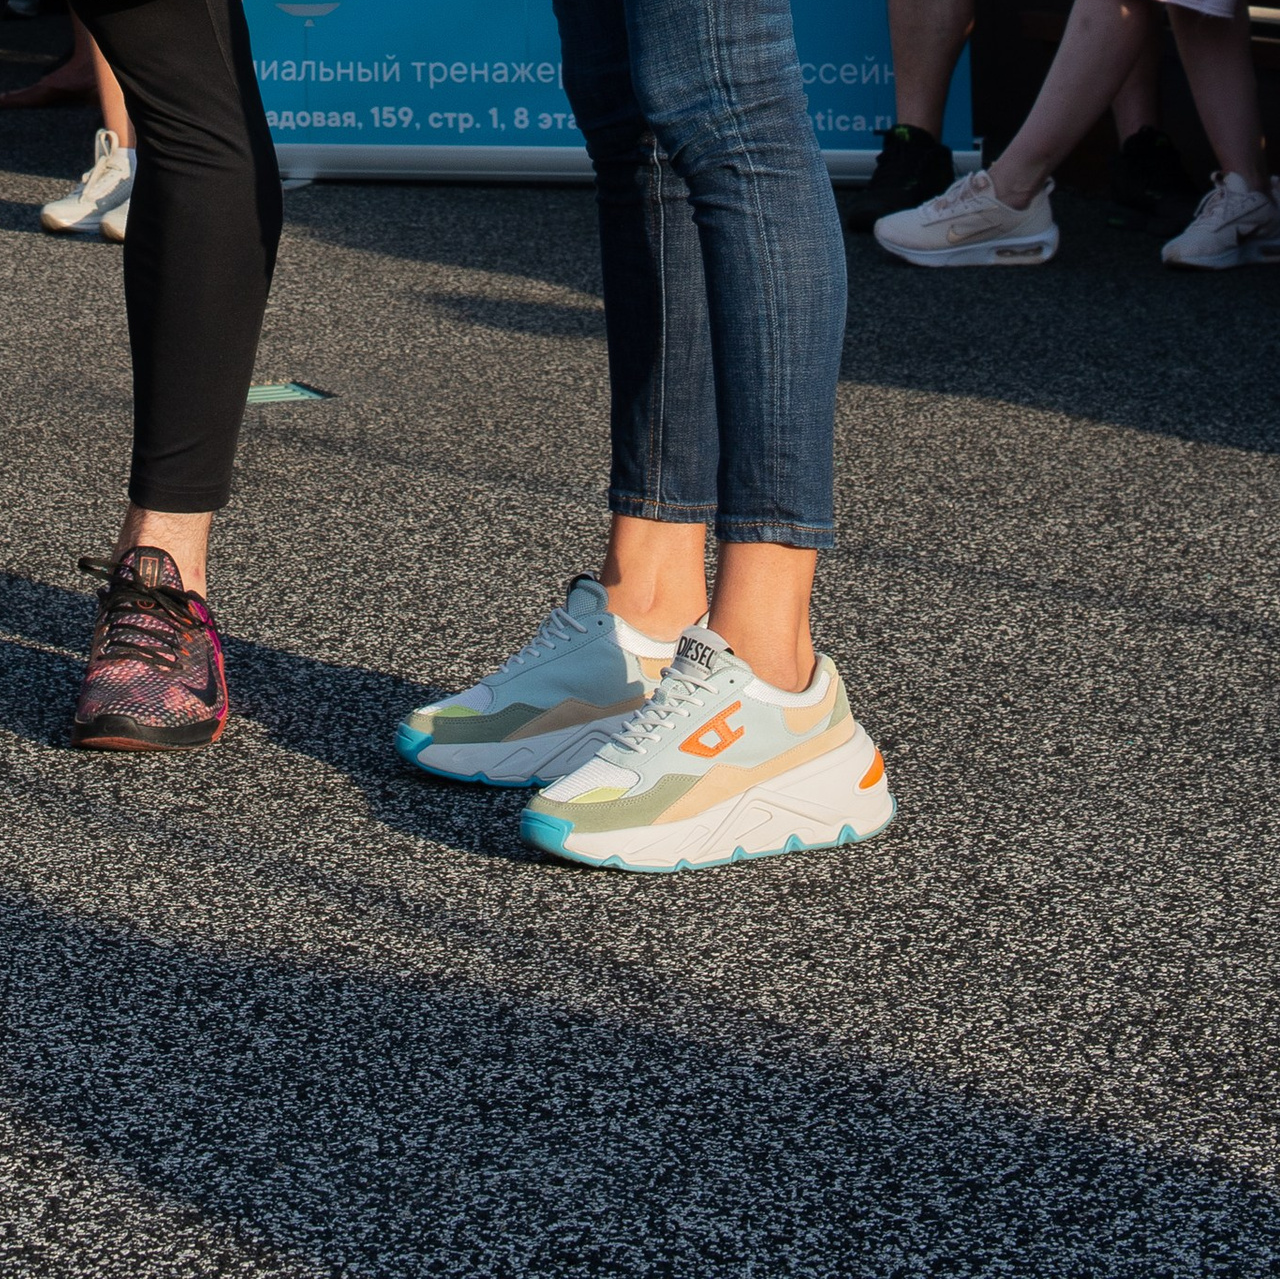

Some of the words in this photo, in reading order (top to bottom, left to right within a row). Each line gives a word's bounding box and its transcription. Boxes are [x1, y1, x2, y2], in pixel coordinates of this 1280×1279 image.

[253, 54, 400, 83] иальный
[370, 106, 421, 131] 159,
[428, 111, 481, 133] стр.
[489, 107, 506, 132] 1,
[514, 106, 530, 129] 8
[677, 636, 715, 669] DIESEL
